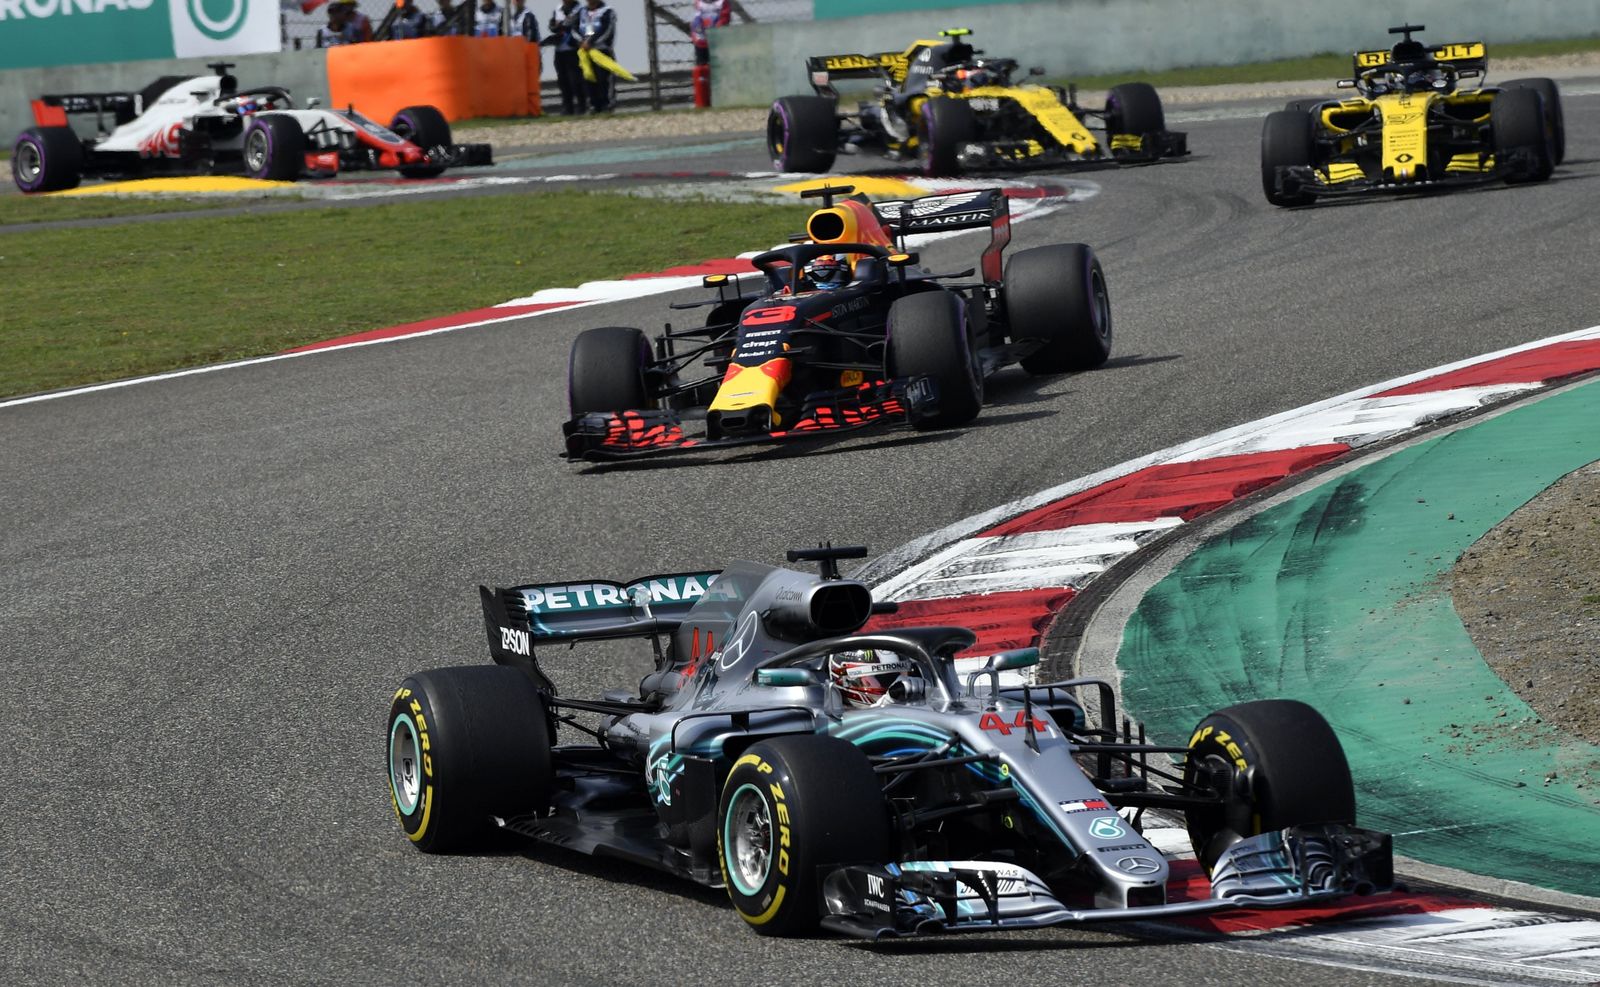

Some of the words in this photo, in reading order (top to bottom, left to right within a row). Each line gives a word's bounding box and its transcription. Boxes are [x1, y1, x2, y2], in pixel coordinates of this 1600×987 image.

[1365, 45, 1476, 64] REULT
[908, 213, 992, 227] MARTIN
[742, 305, 797, 326] 3
[500, 626, 530, 656] EPSON
[979, 709, 1050, 735] 44
[410, 699, 433, 777] ZERO
[1200, 726, 1214, 742] P
[1215, 730, 1248, 772] ZER
[757, 762, 773, 774] P
[770, 781, 790, 876] ZERO
[867, 873, 885, 898] IWC
